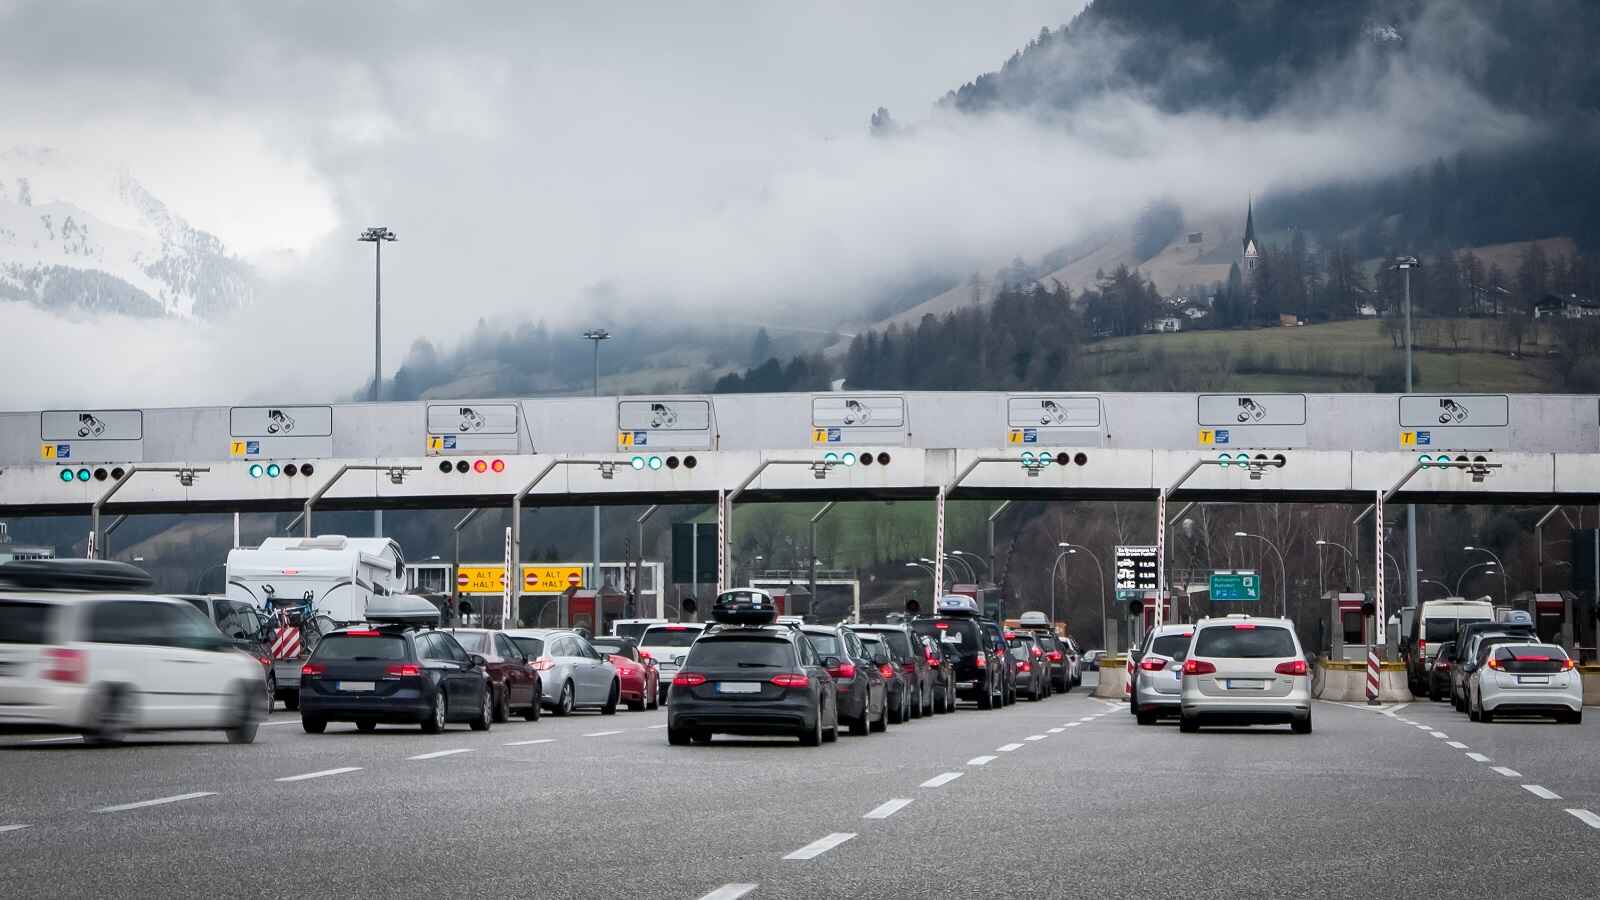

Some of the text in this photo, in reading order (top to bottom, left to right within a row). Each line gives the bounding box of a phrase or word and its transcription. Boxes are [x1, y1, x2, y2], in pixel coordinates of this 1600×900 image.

[622, 432, 631, 444] T
[815, 429, 825, 441] T
[1012, 429, 1020, 442] T
[1201, 431, 1210, 442] T
[1401, 432, 1411, 443] T
[234, 442, 241, 453] T
[431, 436, 440, 448] T
[44, 446, 53, 456] T
[473, 580, 494, 588] HALT
[542, 580, 563, 588] HALT
